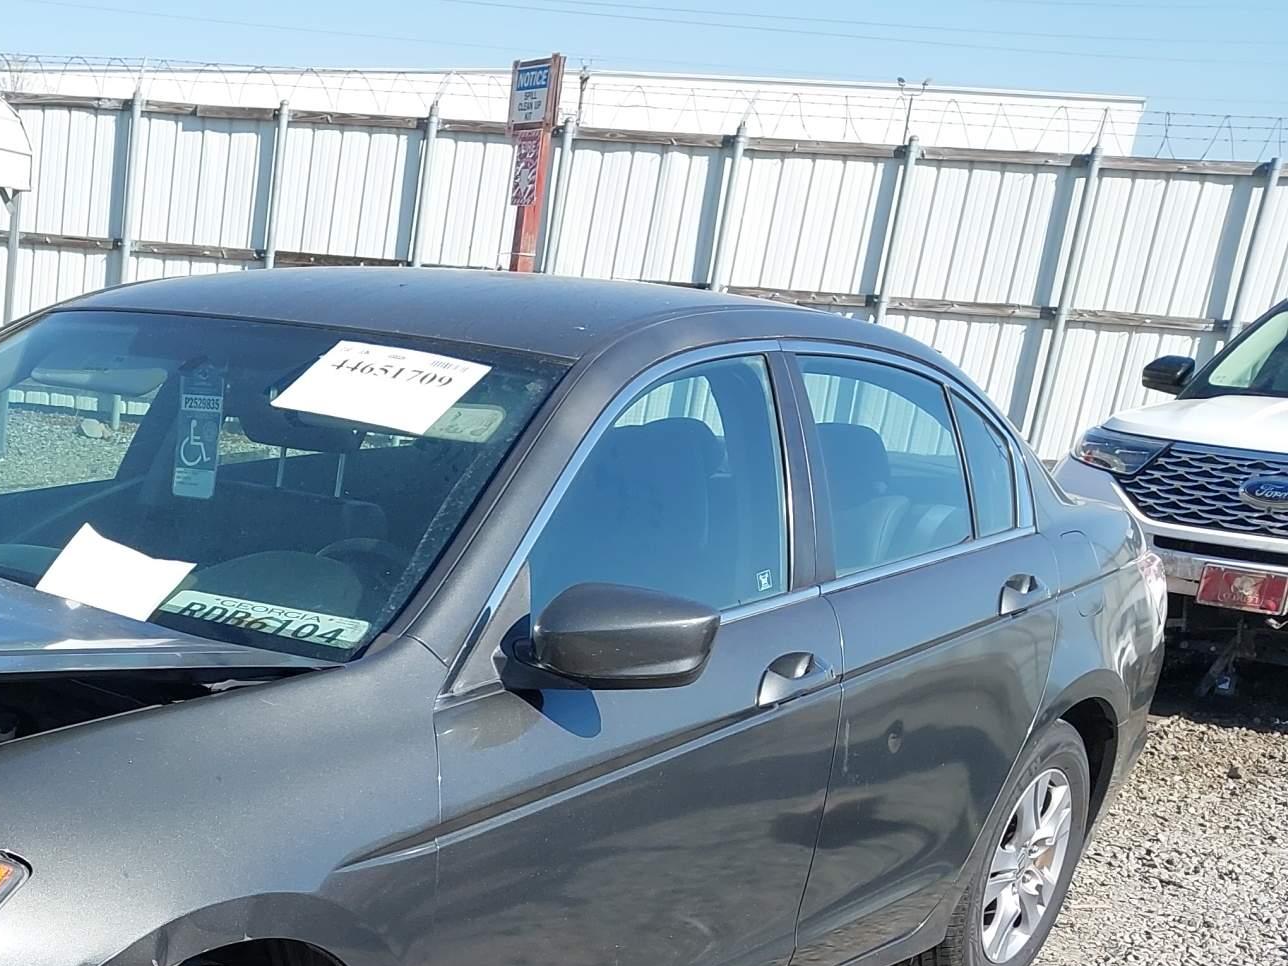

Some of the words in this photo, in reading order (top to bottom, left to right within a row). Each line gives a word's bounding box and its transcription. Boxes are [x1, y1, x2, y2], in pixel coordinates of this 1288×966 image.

[518, 69, 549, 88] NOTICE
[524, 91, 537, 100] SPILL
[518, 101, 533, 111] CLEAN
[534, 100, 542, 110] UP
[524, 111, 532, 120] KIT
[330, 358, 453, 388] 44651709
[220, 599, 321, 623] GEORGIA
